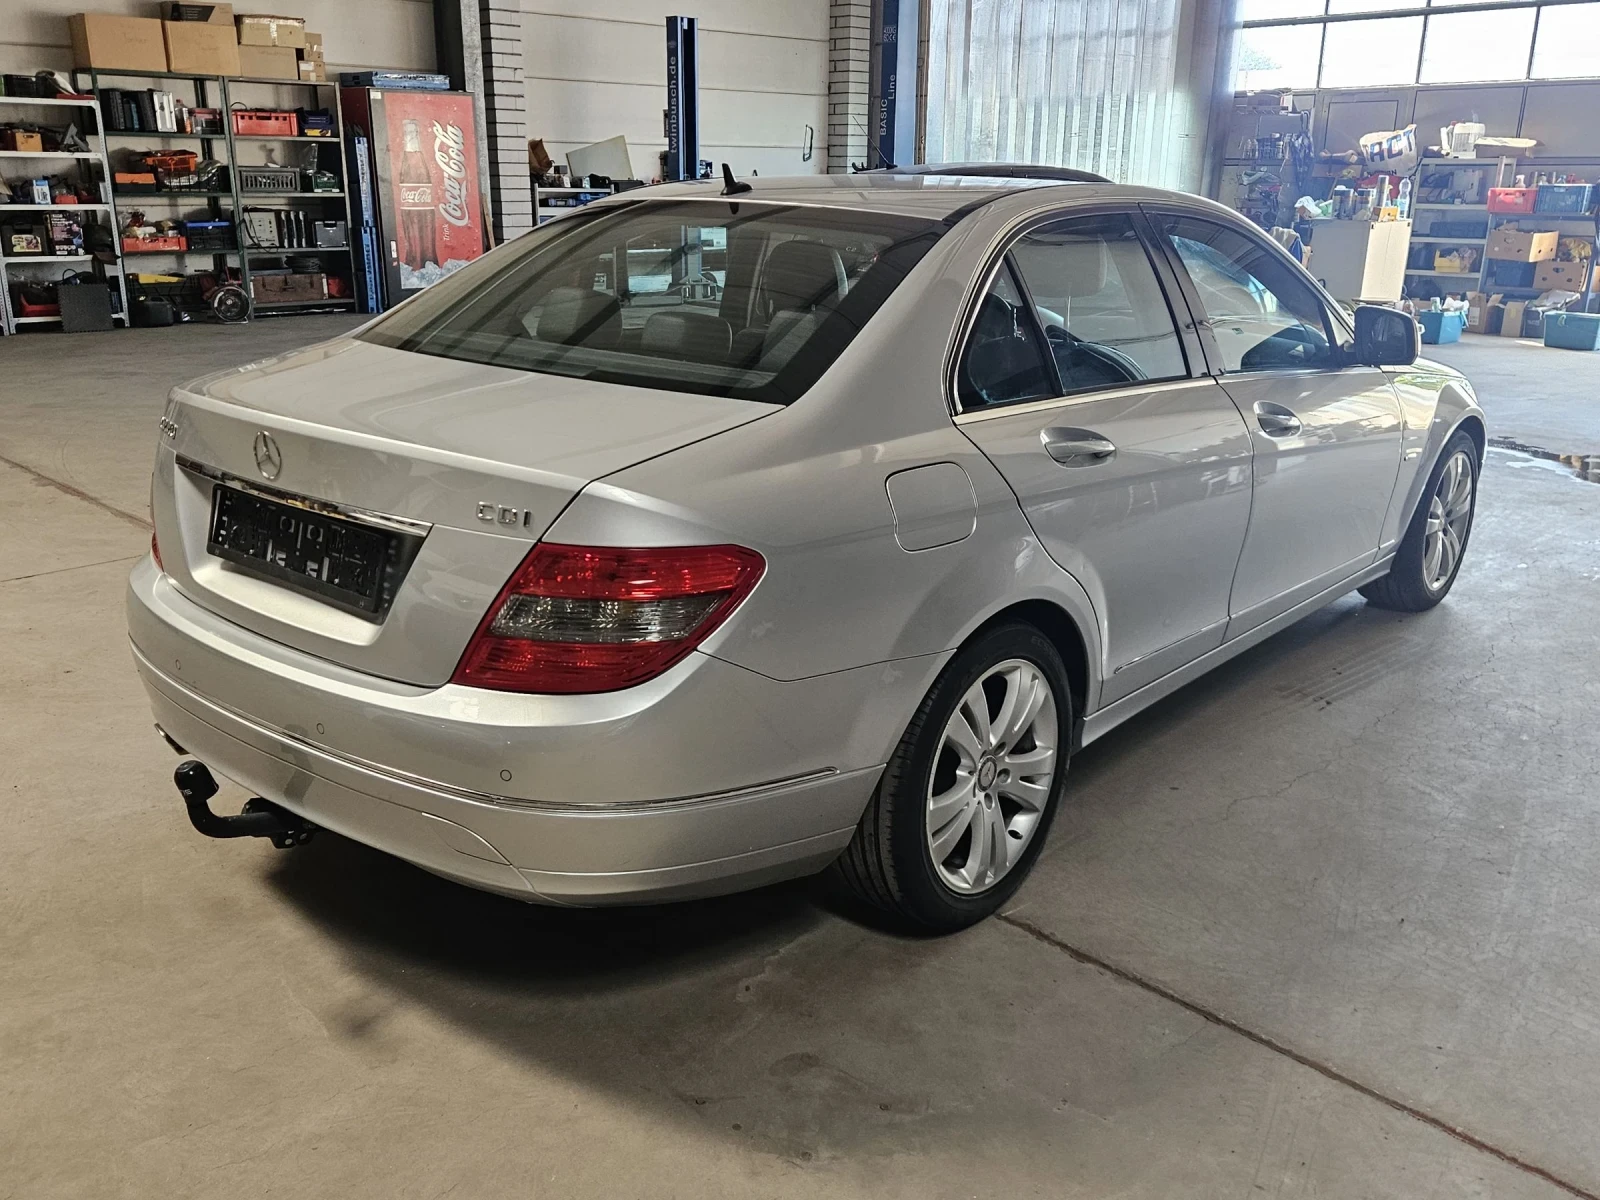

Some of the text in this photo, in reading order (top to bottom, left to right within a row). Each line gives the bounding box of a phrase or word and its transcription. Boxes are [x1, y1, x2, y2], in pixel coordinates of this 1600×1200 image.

[888, 74, 896, 100] Line
[668, 56, 678, 153] twinbusch.de
[879, 99, 888, 136] BASIC
[433, 119, 469, 227] Coca-Cola
[400, 188, 432, 203] Coca-Cola
[476, 500, 532, 528] CDI
